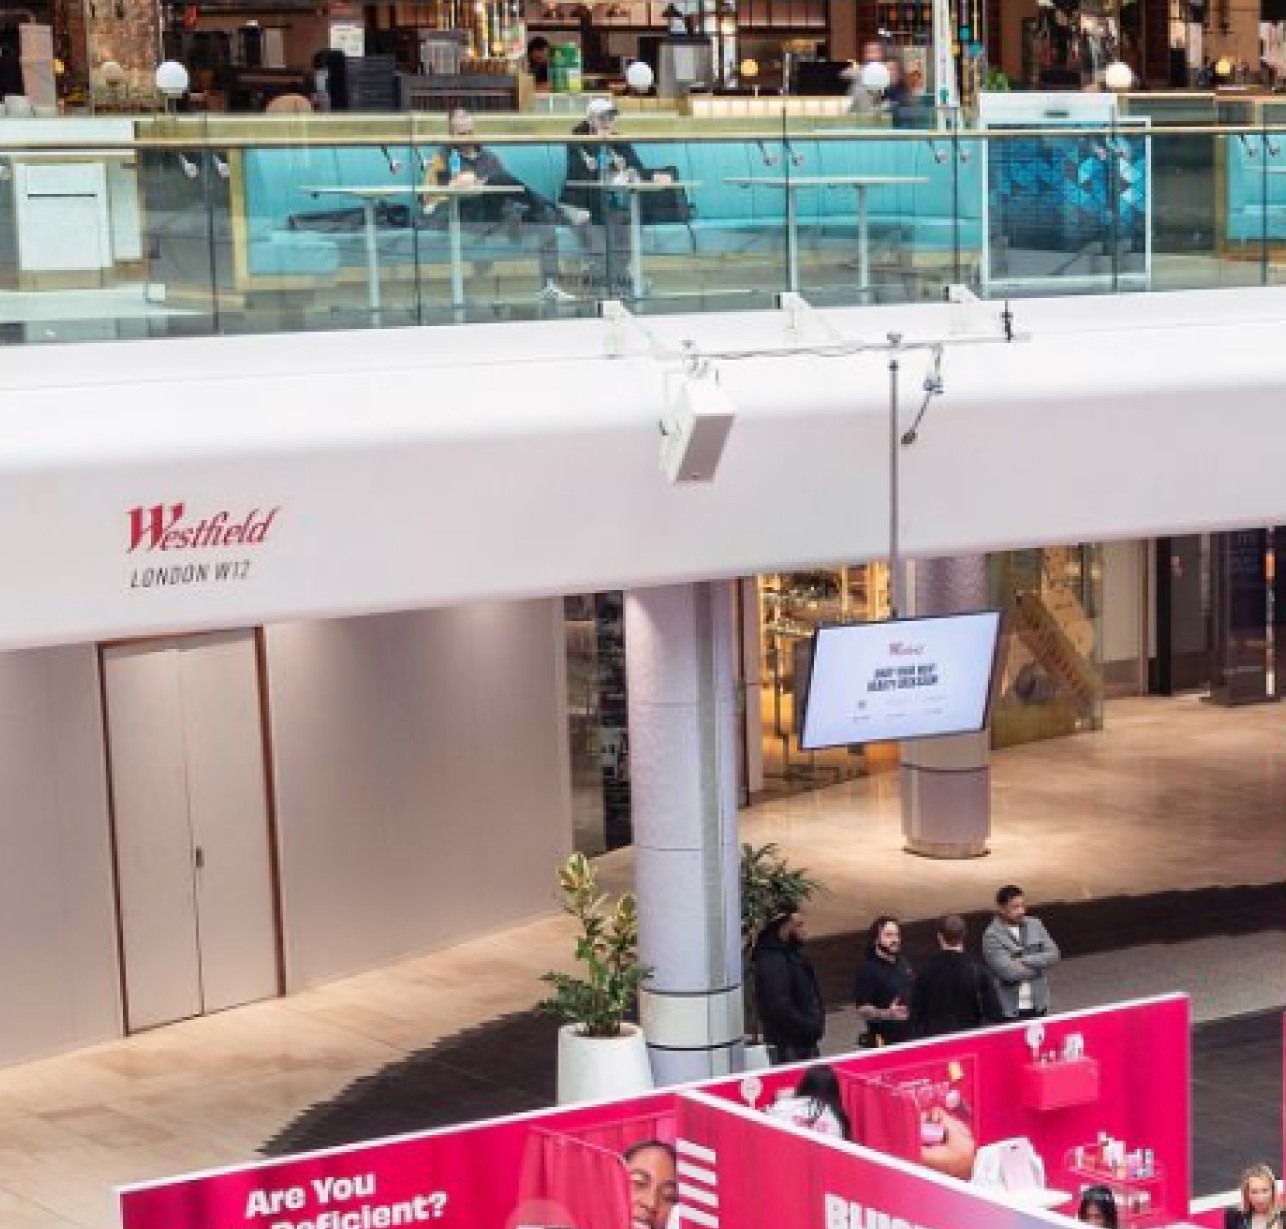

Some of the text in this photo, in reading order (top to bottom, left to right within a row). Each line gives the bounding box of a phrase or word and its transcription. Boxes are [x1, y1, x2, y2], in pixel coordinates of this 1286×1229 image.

[126, 502, 281, 553] Westfield
[130, 559, 251, 588] LONDON W12
[246, 1172, 376, 1219] Are You
